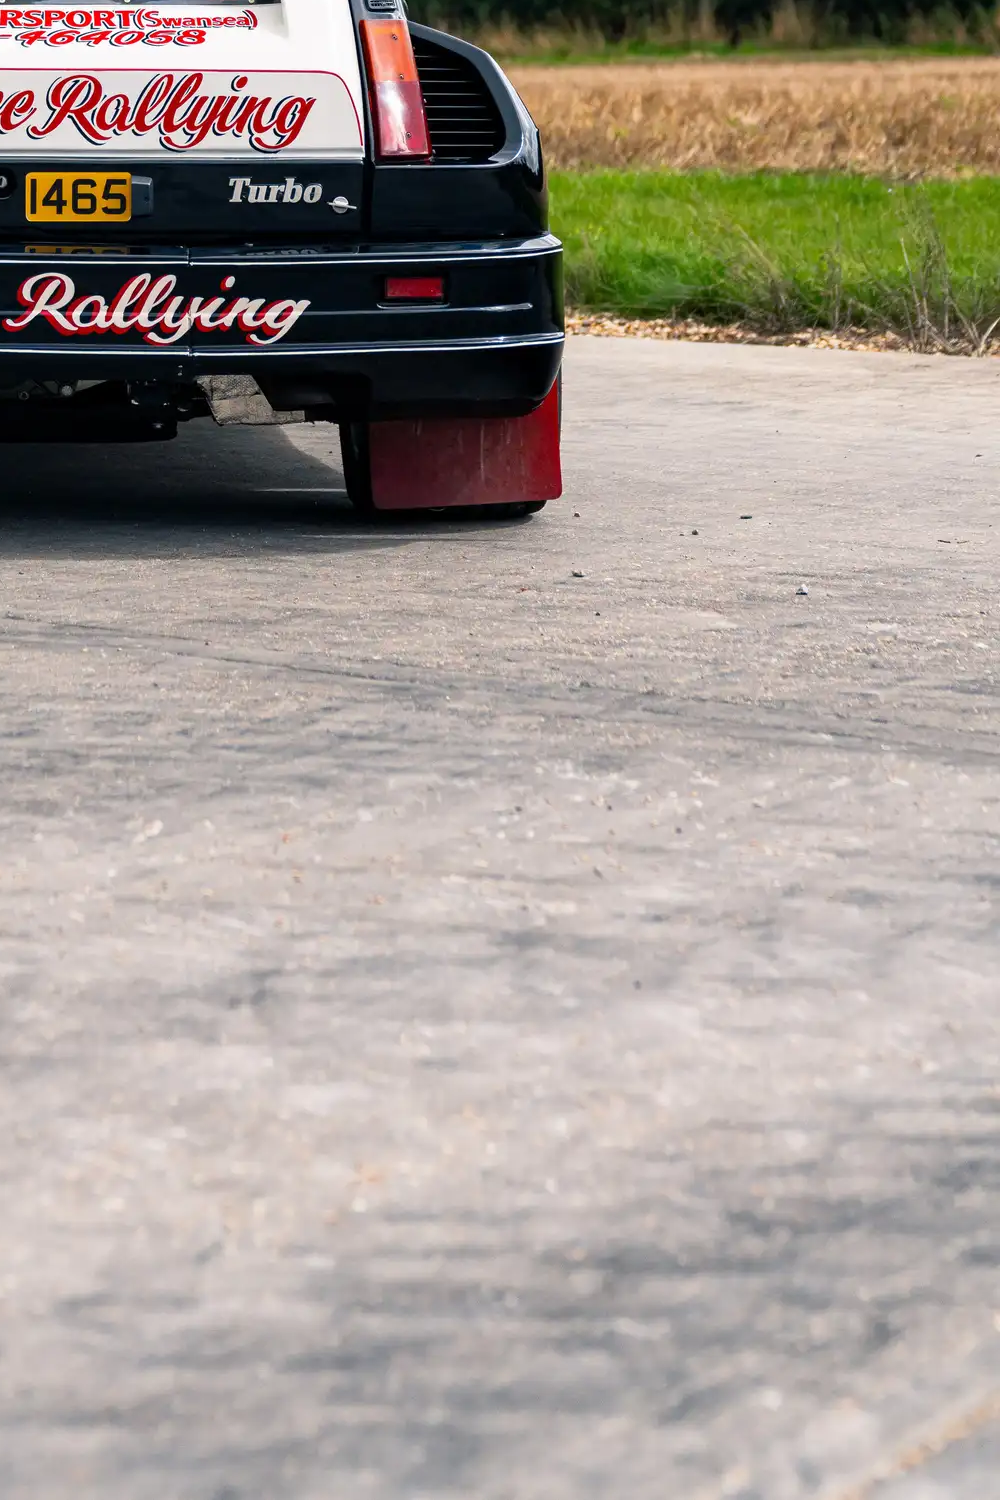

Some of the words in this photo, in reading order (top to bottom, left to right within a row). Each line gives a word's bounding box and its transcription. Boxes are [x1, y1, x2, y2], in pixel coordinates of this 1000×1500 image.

[26, 72, 317, 153] Rallying
[29, 177, 128, 215] 1465
[228, 175, 324, 204] Turbo
[2, 272, 312, 347] Rallying
